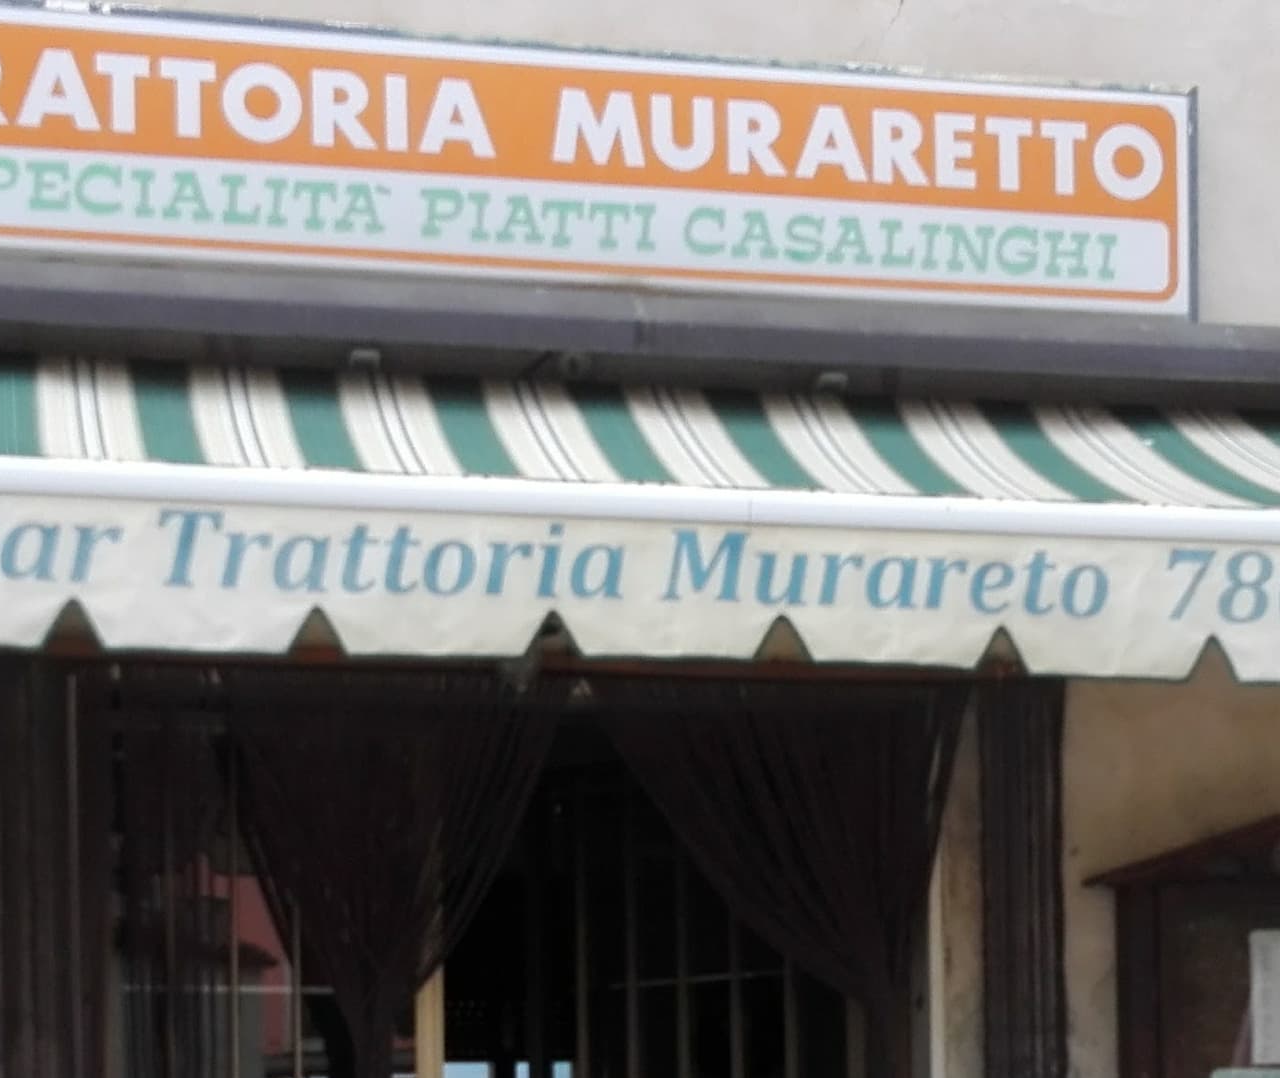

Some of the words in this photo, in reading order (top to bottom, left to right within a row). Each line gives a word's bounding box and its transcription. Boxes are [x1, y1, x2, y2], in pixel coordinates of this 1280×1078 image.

[552, 87, 1164, 201] MURARETTO
[420, 186, 656, 251] PIATTI
[683, 206, 1118, 282] CASALINGHI
[158, 509, 625, 600] Trattoria
[660, 530, 1110, 618] Murareto
